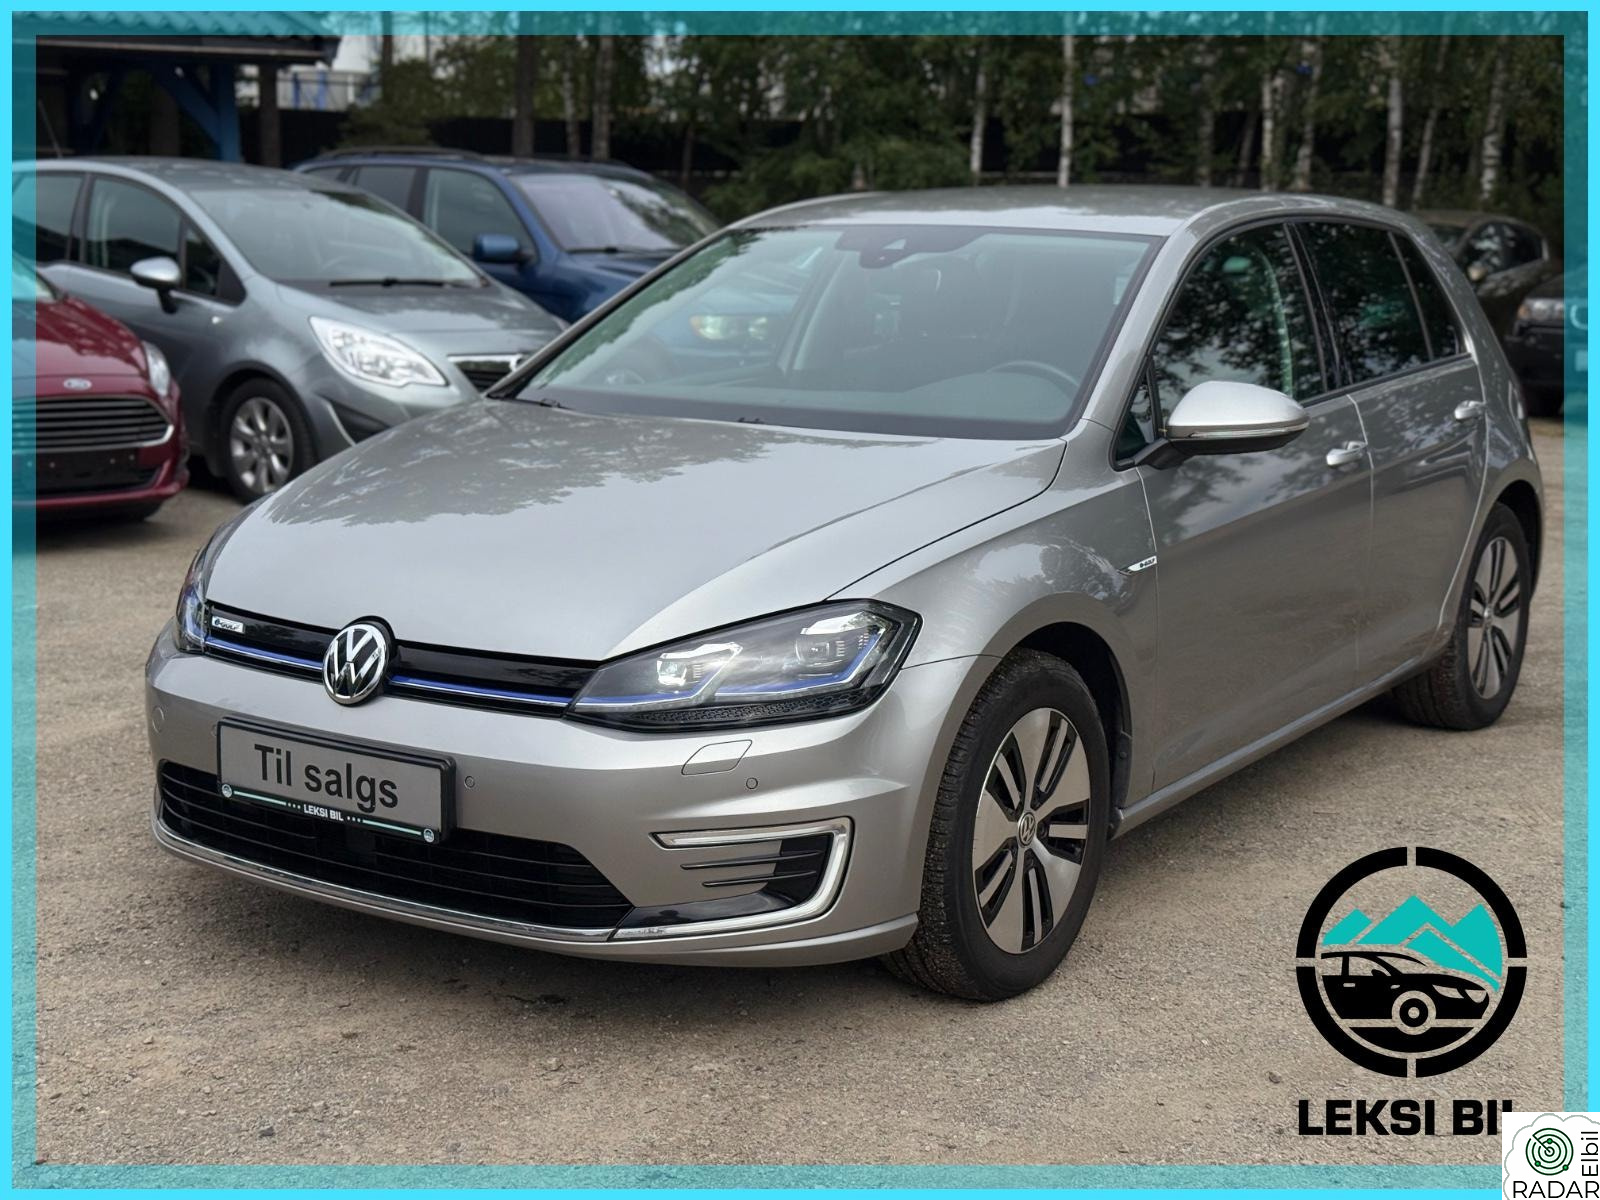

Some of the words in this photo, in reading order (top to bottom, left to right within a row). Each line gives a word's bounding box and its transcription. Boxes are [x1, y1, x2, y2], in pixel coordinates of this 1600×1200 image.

[254, 743, 292, 787] Til
[304, 763, 399, 814] salgs
[303, 803, 329, 818] LEKSI
[329, 809, 344, 821] BIL
